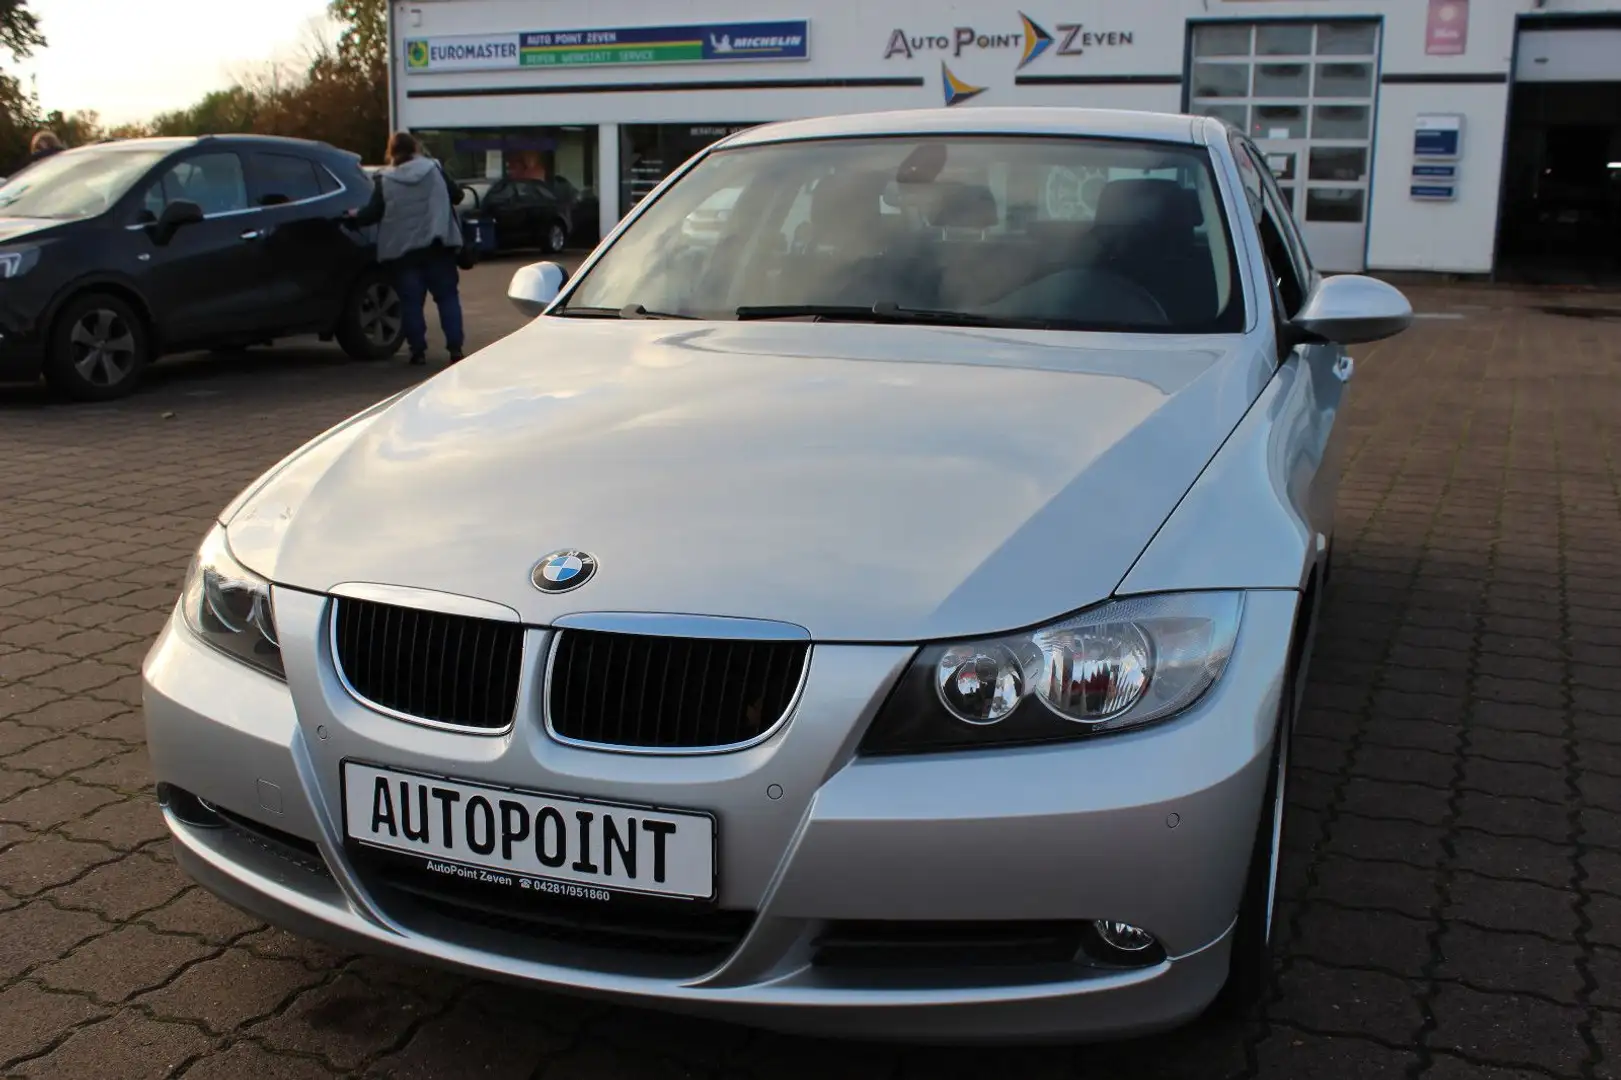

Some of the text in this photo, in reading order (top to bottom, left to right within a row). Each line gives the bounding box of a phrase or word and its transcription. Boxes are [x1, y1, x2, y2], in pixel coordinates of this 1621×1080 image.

[526, 31, 617, 46] AUTO POINT ZEVEN
[733, 35, 802, 49] MICHELIN
[884, 24, 1133, 59] AUTO POINT ZEVEN
[430, 42, 517, 61] EUROMASTER
[561, 51, 612, 63] WERKSTATT
[617, 49, 656, 61] SERVICE
[371, 776, 677, 883] AUTOPOINT
[426, 860, 611, 902] AutoPoint Zeven 04281/951860
